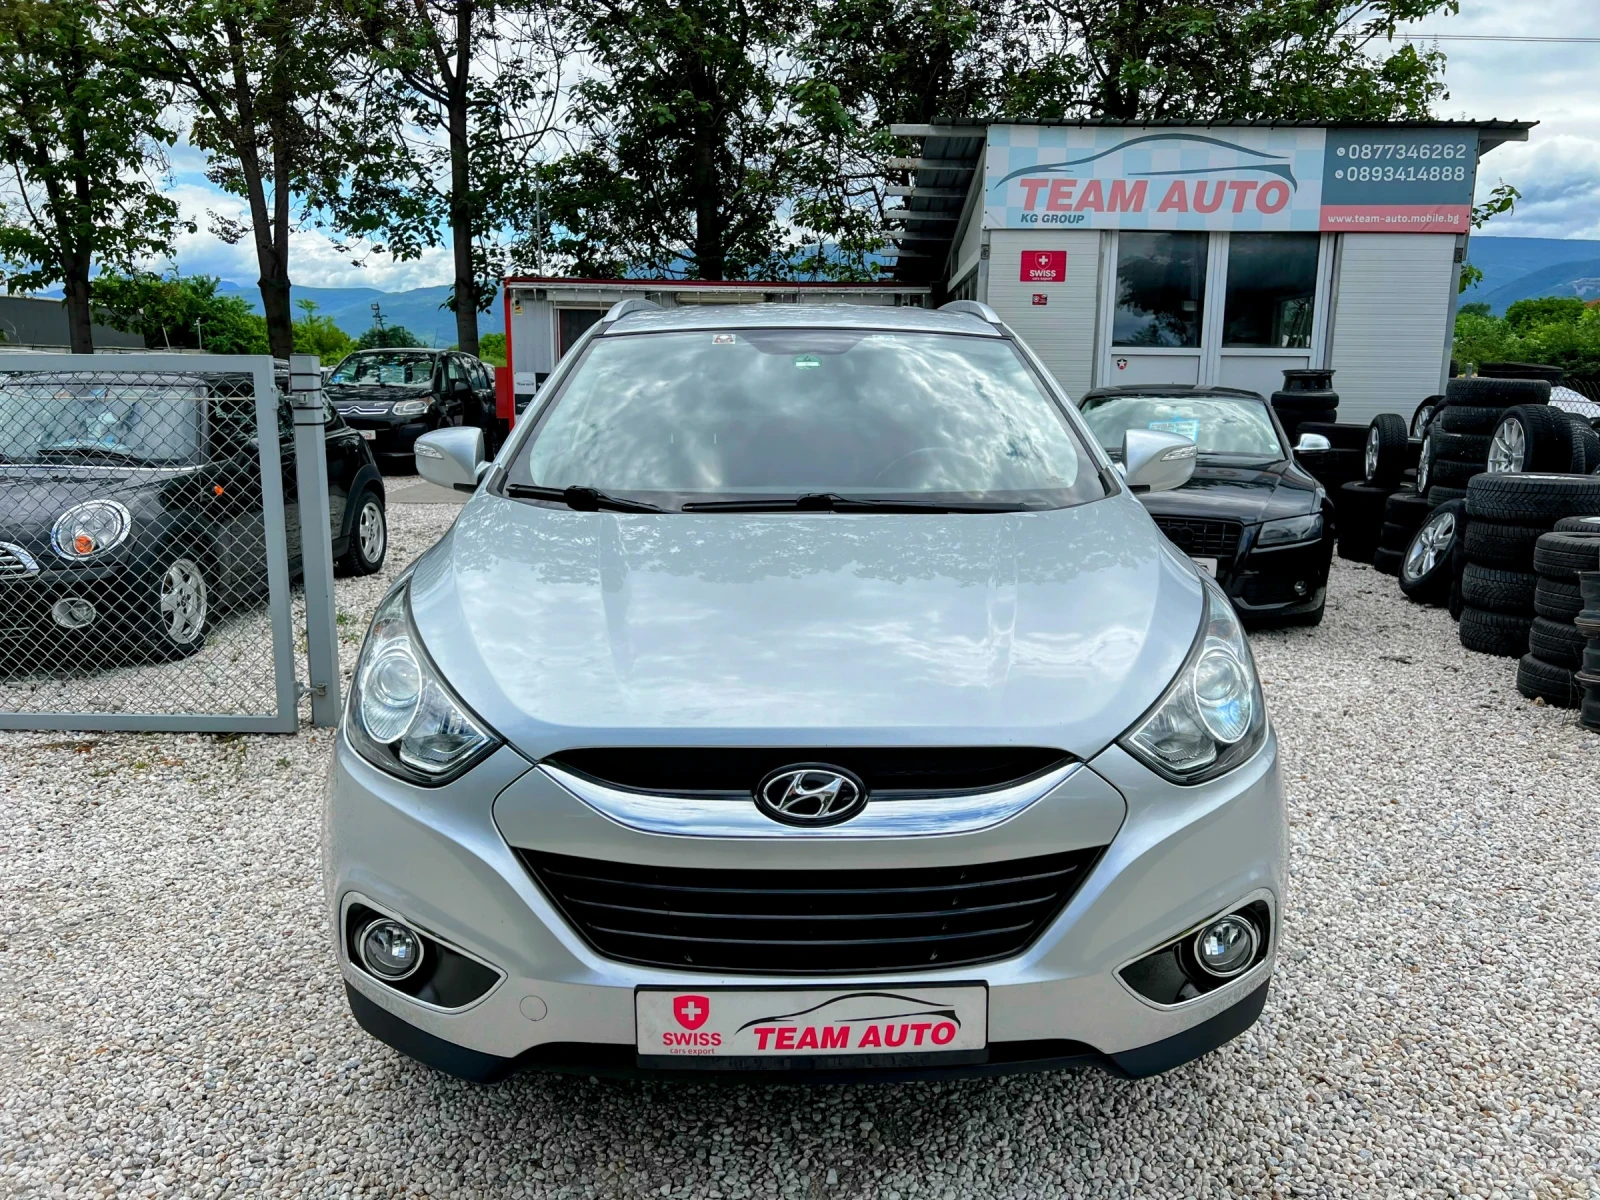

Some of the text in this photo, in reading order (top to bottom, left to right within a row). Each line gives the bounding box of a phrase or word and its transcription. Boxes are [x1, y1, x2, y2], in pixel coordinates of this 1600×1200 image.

[1348, 144, 1467, 160] 0877346262
[1346, 166, 1465, 182] 0893414888
[1020, 179, 1290, 214] TEAM AUTO
[1020, 214, 1085, 224] KG GROUP
[1328, 214, 1459, 224] www.team-auto.mobile.bg
[1029, 269, 1056, 277] SWISS
[662, 1032, 722, 1046] SWISS
[754, 1022, 956, 1050] TEAM AUTO
[687, 1047, 715, 1056] export
